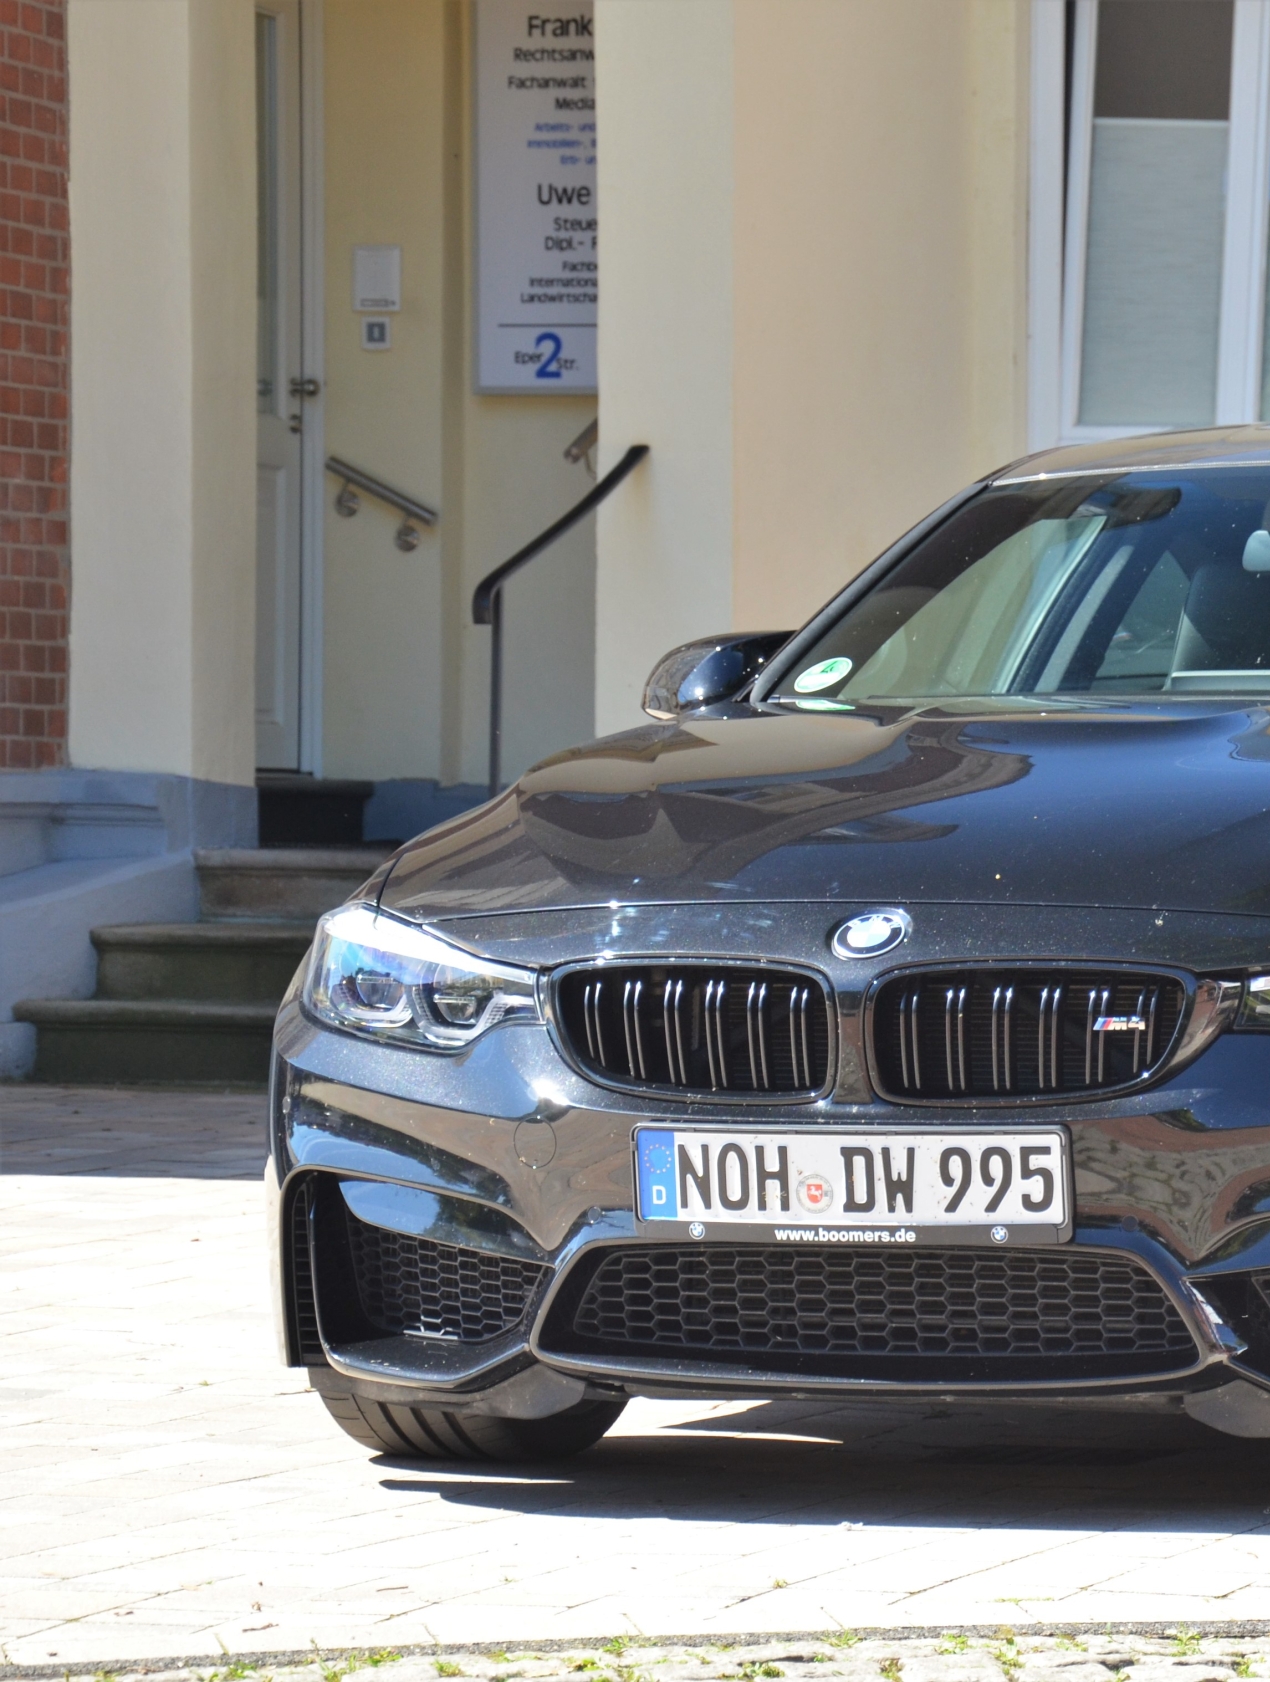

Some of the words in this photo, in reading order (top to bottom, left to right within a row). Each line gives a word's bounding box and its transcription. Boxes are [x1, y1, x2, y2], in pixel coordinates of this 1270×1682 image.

[527, 14, 593, 38] Frank
[508, 76, 587, 90] Fachanwalt
[537, 183, 591, 206] Uwe
[514, 351, 544, 365] Eper
[534, 331, 563, 379] 2
[677, 1142, 789, 1213] NOH
[839, 1146, 916, 1214] DW
[938, 1145, 1056, 1215] 995
[652, 1185, 667, 1205] D
[774, 1227, 917, 1243] www.boomers.de
